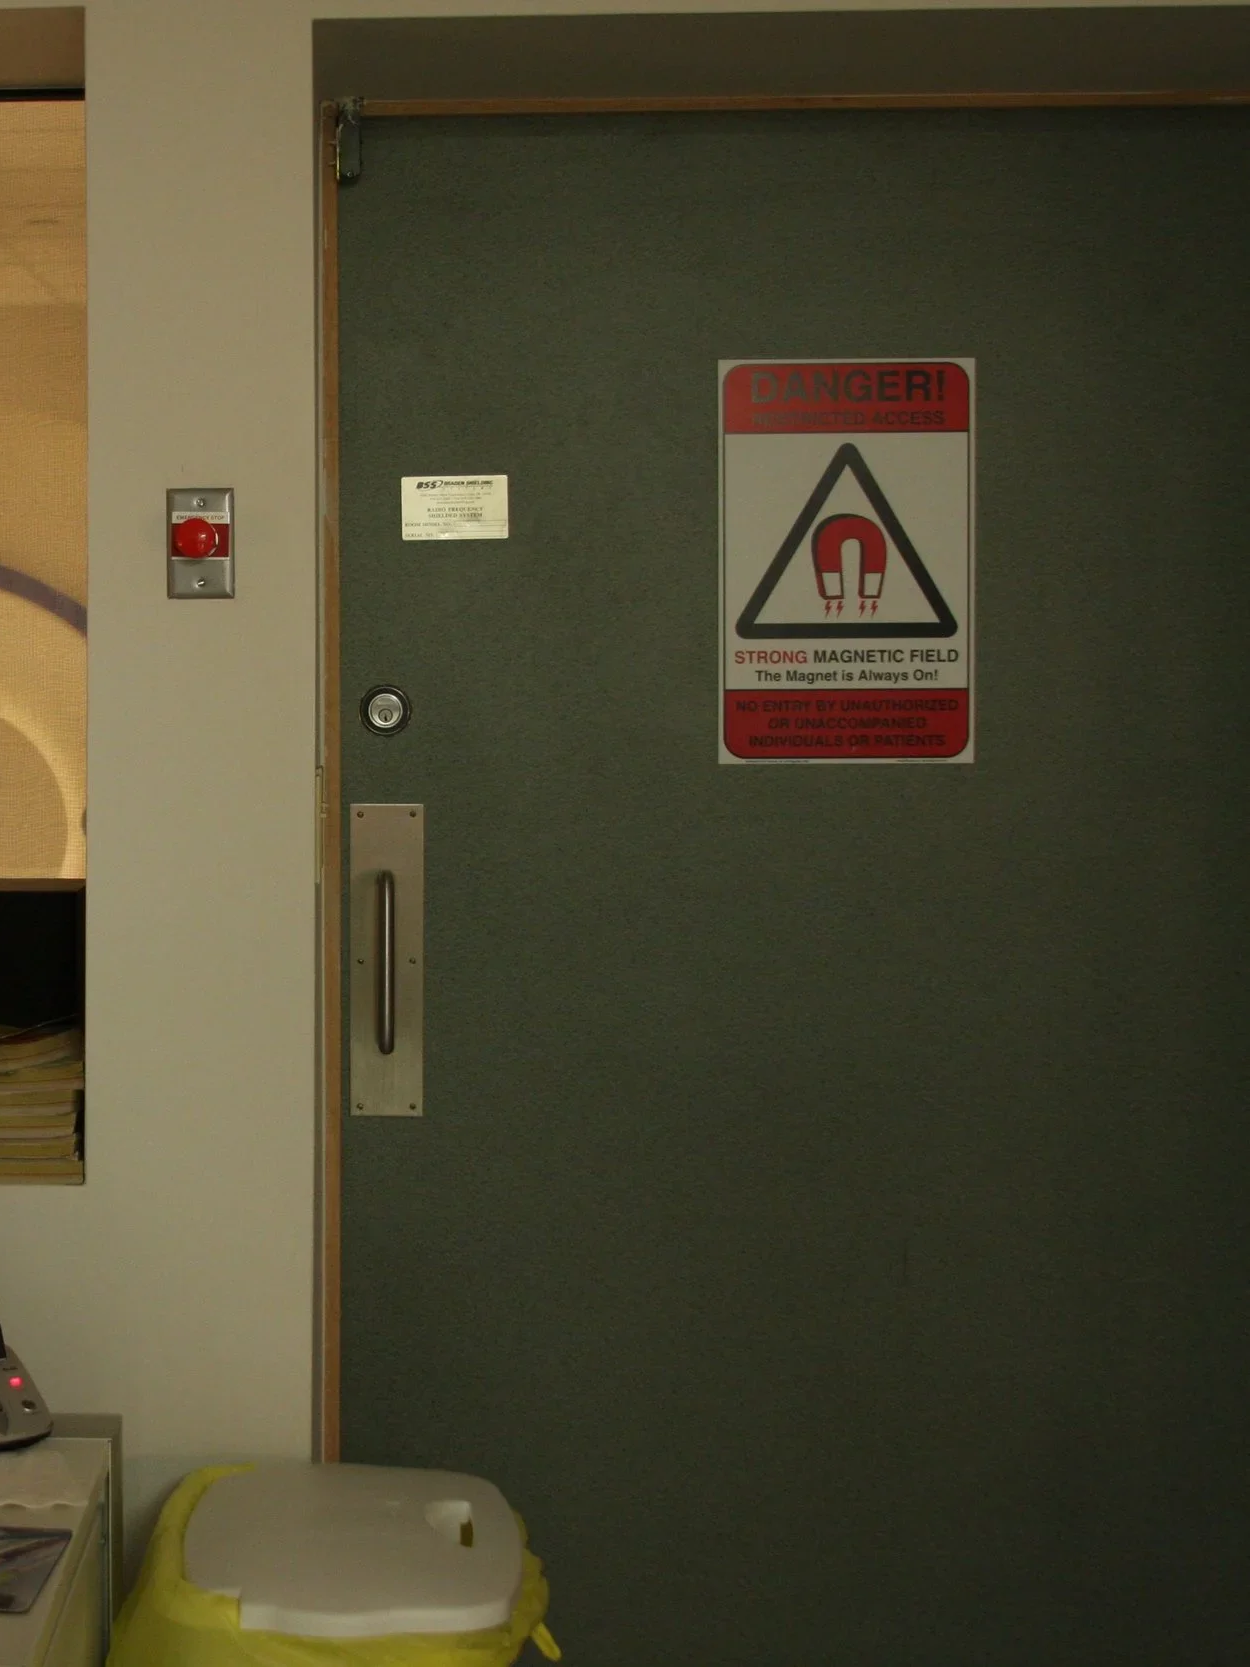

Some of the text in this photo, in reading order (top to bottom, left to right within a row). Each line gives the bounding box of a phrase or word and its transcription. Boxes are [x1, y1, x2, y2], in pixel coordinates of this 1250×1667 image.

[751, 369, 946, 403] DANGER!
[754, 410, 946, 426] RESTRICTED ACCESS
[734, 649, 959, 665] STRONG MAGNETIC FIELD
[755, 669, 939, 684] The Magnet is Always On!
[735, 699, 959, 713] NO ENTRY BY UNAUTHORIZED
[768, 717, 927, 729] OR UNACCOMPANIED
[749, 734, 946, 748] INDIVIDUALS OR PATIENTS
